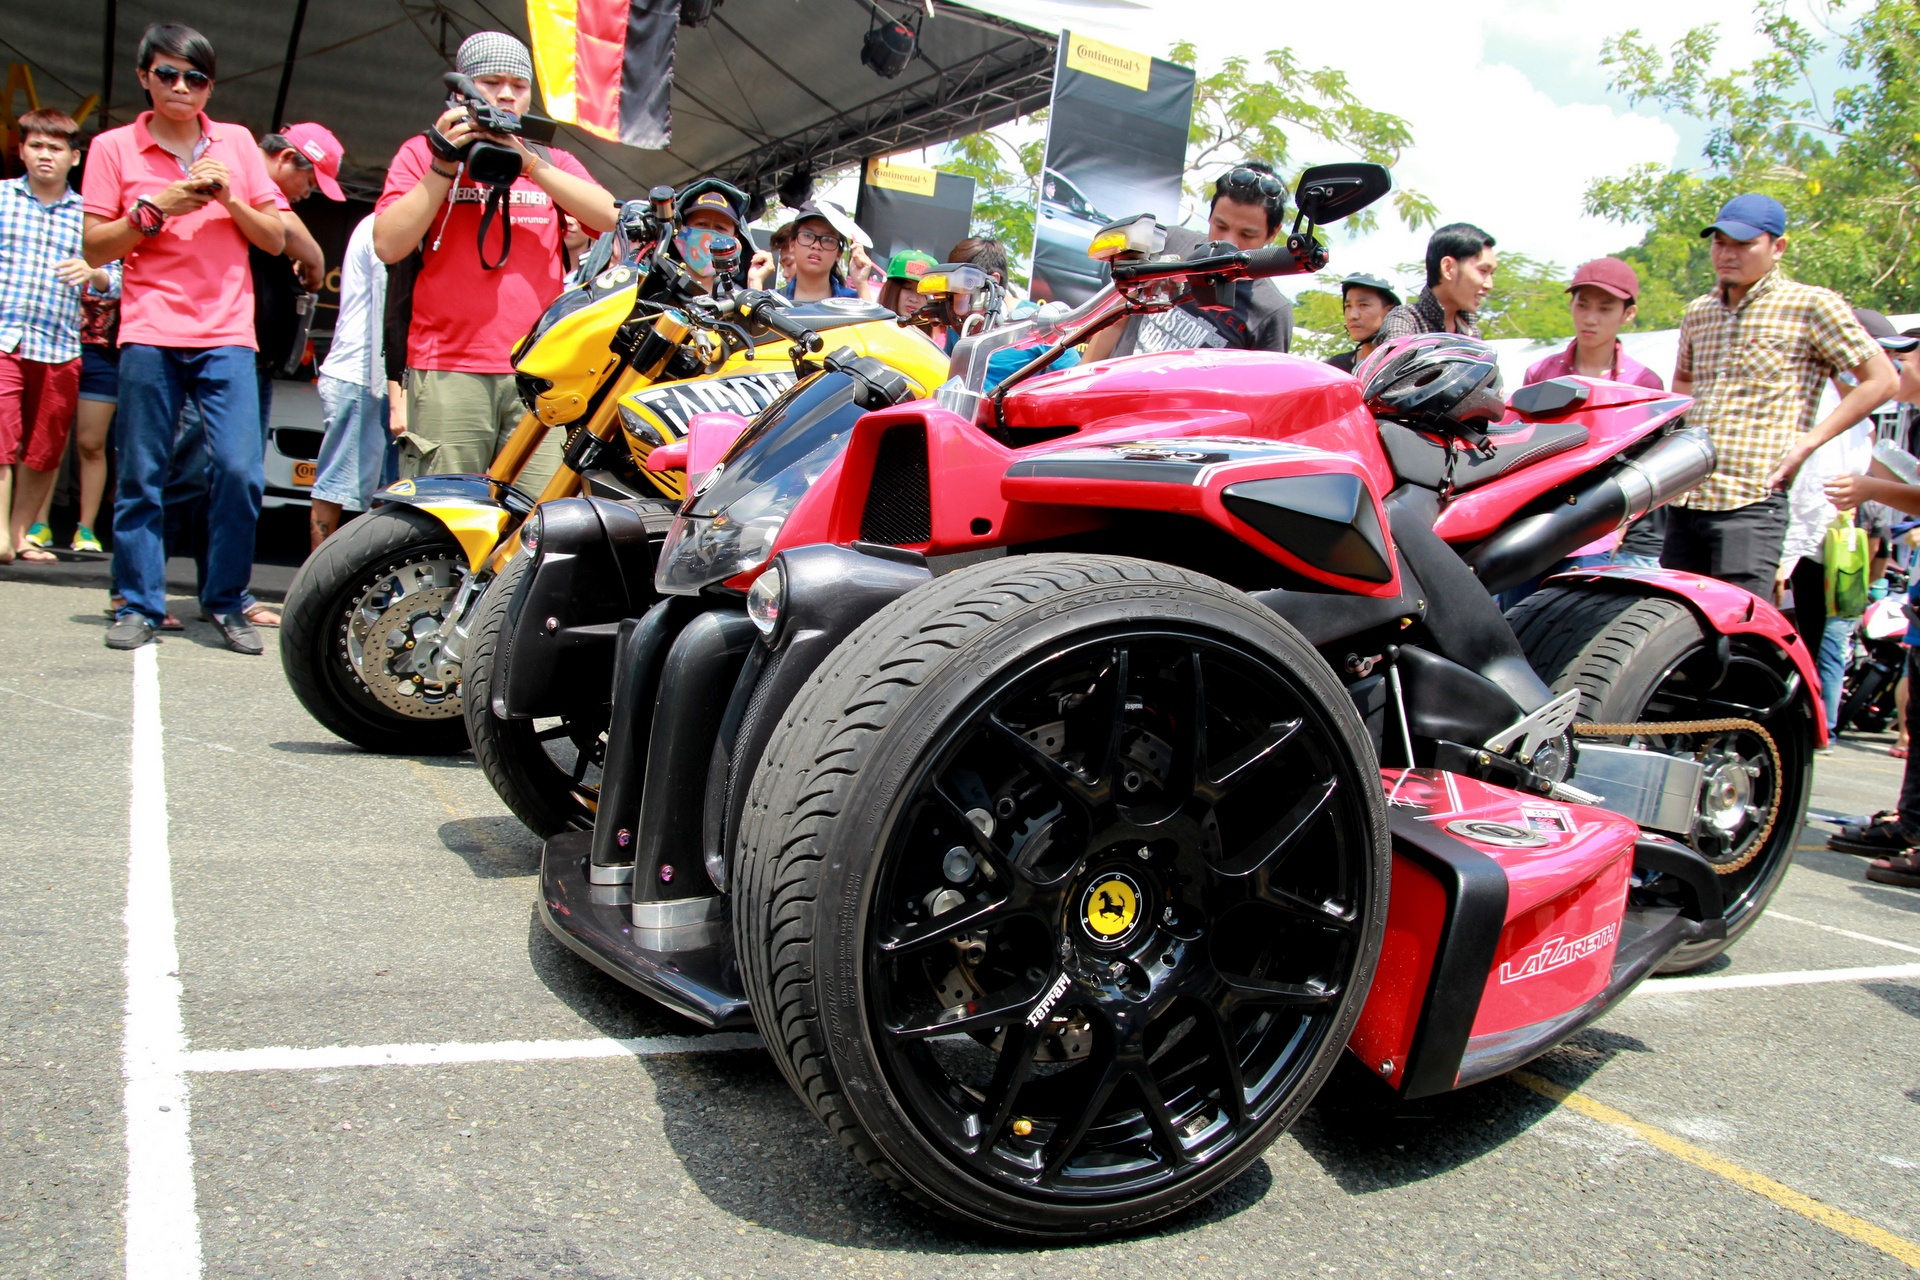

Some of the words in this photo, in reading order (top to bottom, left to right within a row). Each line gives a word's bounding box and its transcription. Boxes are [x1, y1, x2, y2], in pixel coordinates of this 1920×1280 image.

[1076, 44, 1132, 71] Continental
[873, 167, 920, 184] Continental
[1500, 922, 1616, 985] LAZARETH
[1027, 971, 1072, 1028] Ferrari
